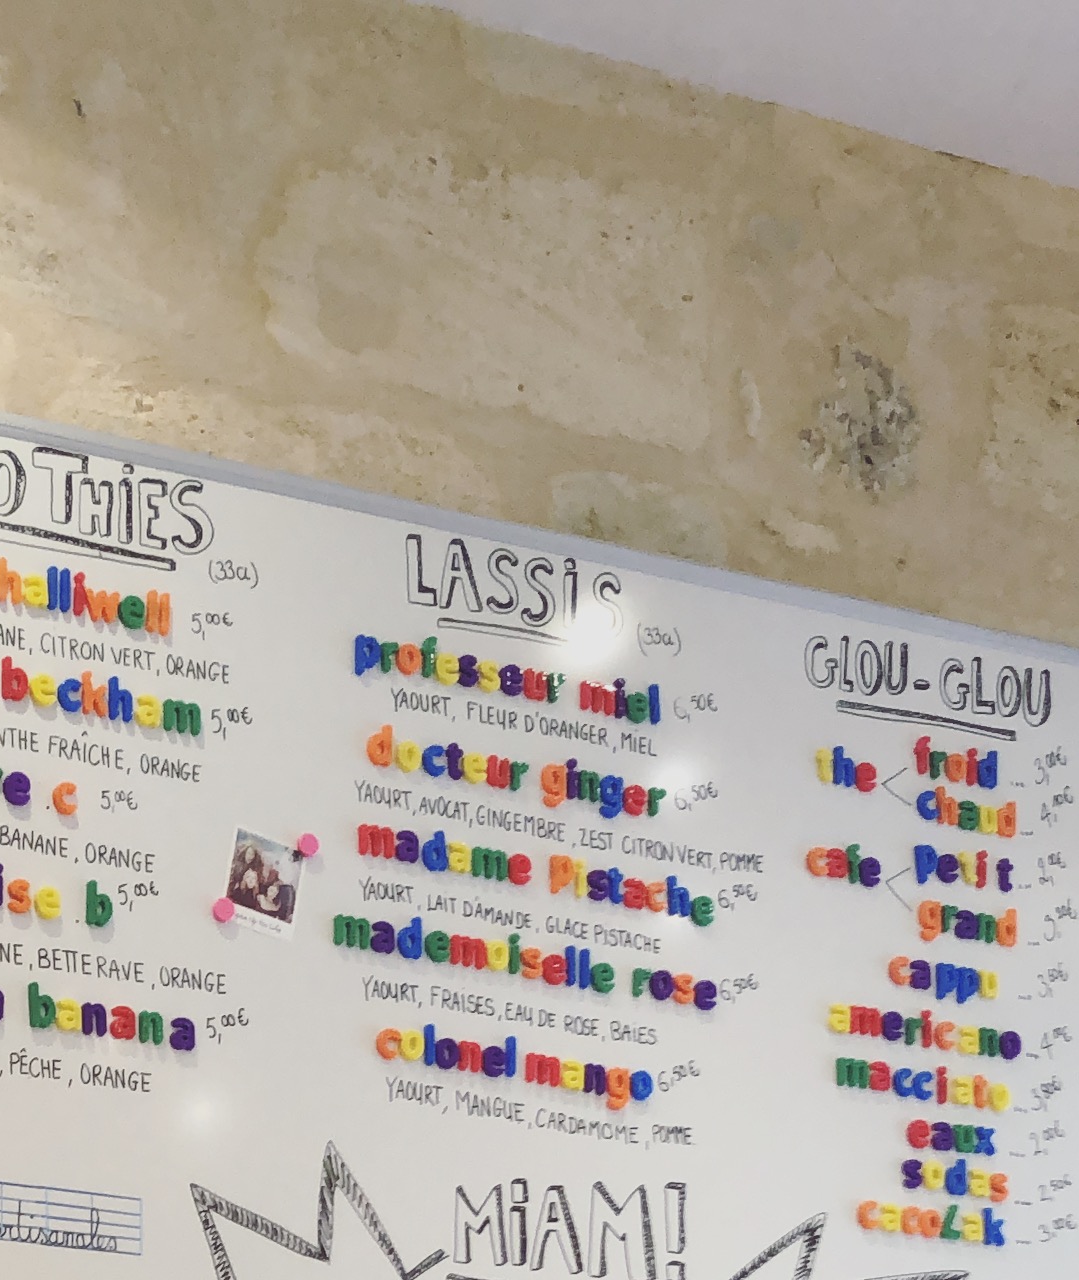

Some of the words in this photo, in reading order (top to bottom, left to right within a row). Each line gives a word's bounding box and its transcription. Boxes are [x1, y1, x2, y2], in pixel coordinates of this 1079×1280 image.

[40, 632, 105, 663] CITRON
[166, 654, 230, 684] ORANGE
[354, 634, 566, 704] professeur
[580, 678, 661, 725] miel
[2, 653, 201, 737] beckham
[467, 701, 517, 730] FLEUR
[140, 753, 202, 783] ORANGE
[366, 724, 529, 791] docteur
[540, 757, 666, 819] ginger
[815, 745, 877, 793] the
[913, 736, 997, 789] froid
[916, 786, 1016, 838] chaud
[85, 843, 156, 873] ORANGE
[358, 824, 532, 886] madame
[720, 852, 764, 873] POMME
[806, 843, 881, 888] cafe
[427, 894, 456, 914] LAIT
[546, 915, 588, 940] GLACE
[594, 924, 661, 954] PISTACHE
[916, 899, 1017, 947] grand
[159, 965, 227, 995] ORANGE
[332, 914, 615, 994] mademoiselle
[632, 967, 717, 1011] rose
[28, 981, 195, 1051] banana
[828, 1002, 1021, 1060] americano
[80, 1063, 152, 1092] ORANGE
[376, 1023, 517, 1078] colonel
[525, 1052, 653, 1111] mango
[906, 1119, 995, 1156] eaux
[901, 1159, 1008, 1203] sodas
